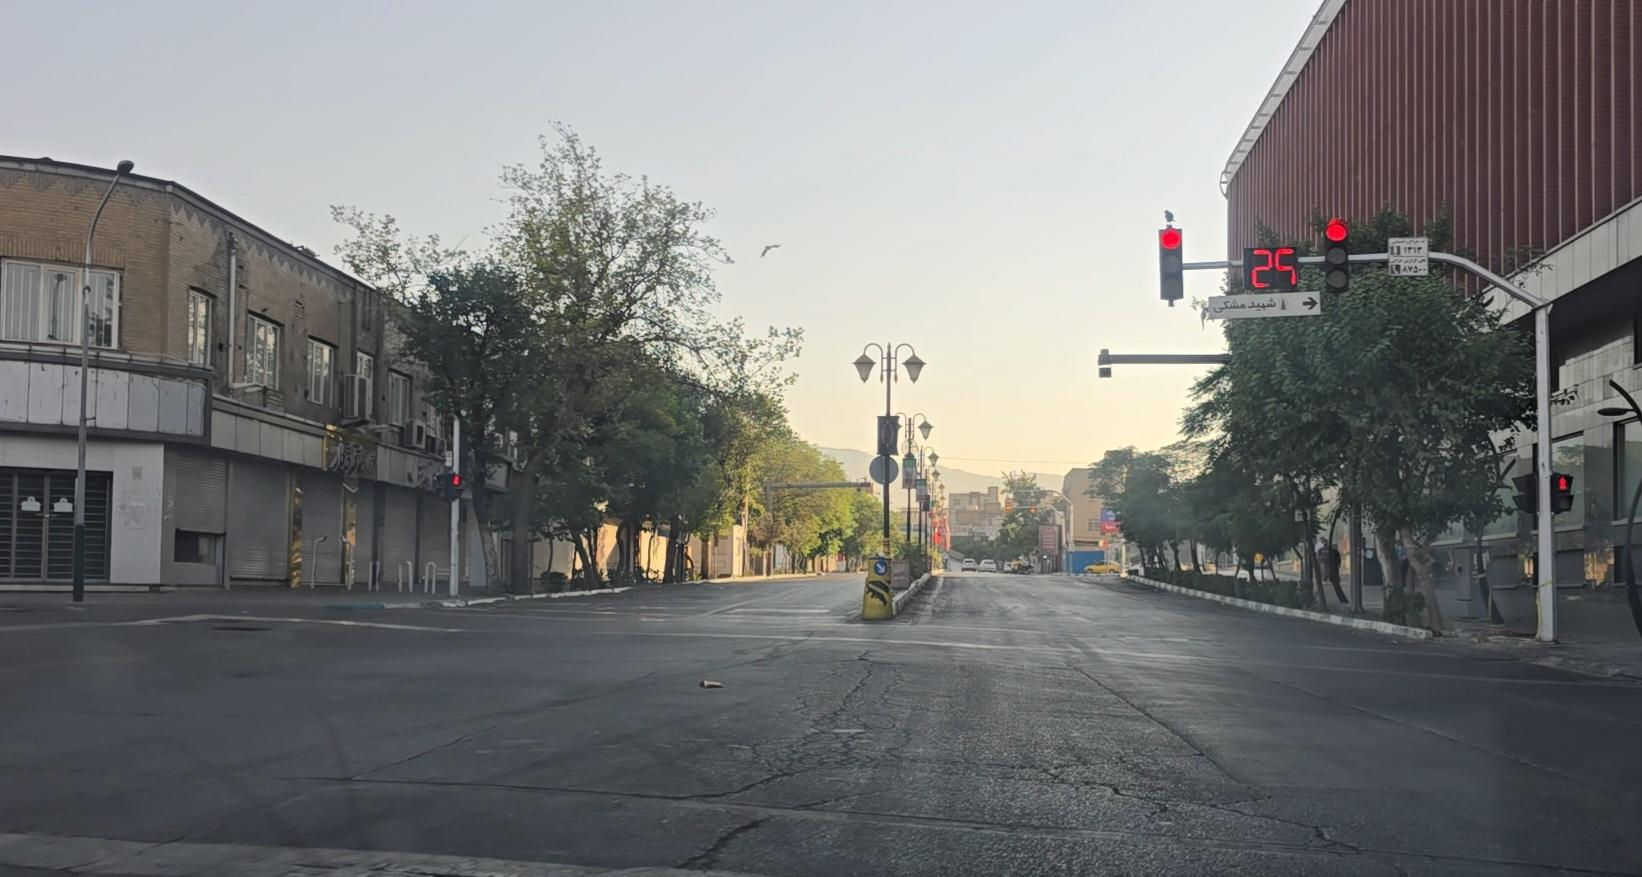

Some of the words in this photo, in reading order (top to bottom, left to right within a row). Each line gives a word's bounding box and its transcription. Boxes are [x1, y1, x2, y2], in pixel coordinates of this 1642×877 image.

[1251, 248, 1297, 288] 25
[1402, 265, 1426, 273] ۸۷۵۰۰
[1213, 299, 1246, 313] مشکی
[1248, 298, 1277, 311] شهید
